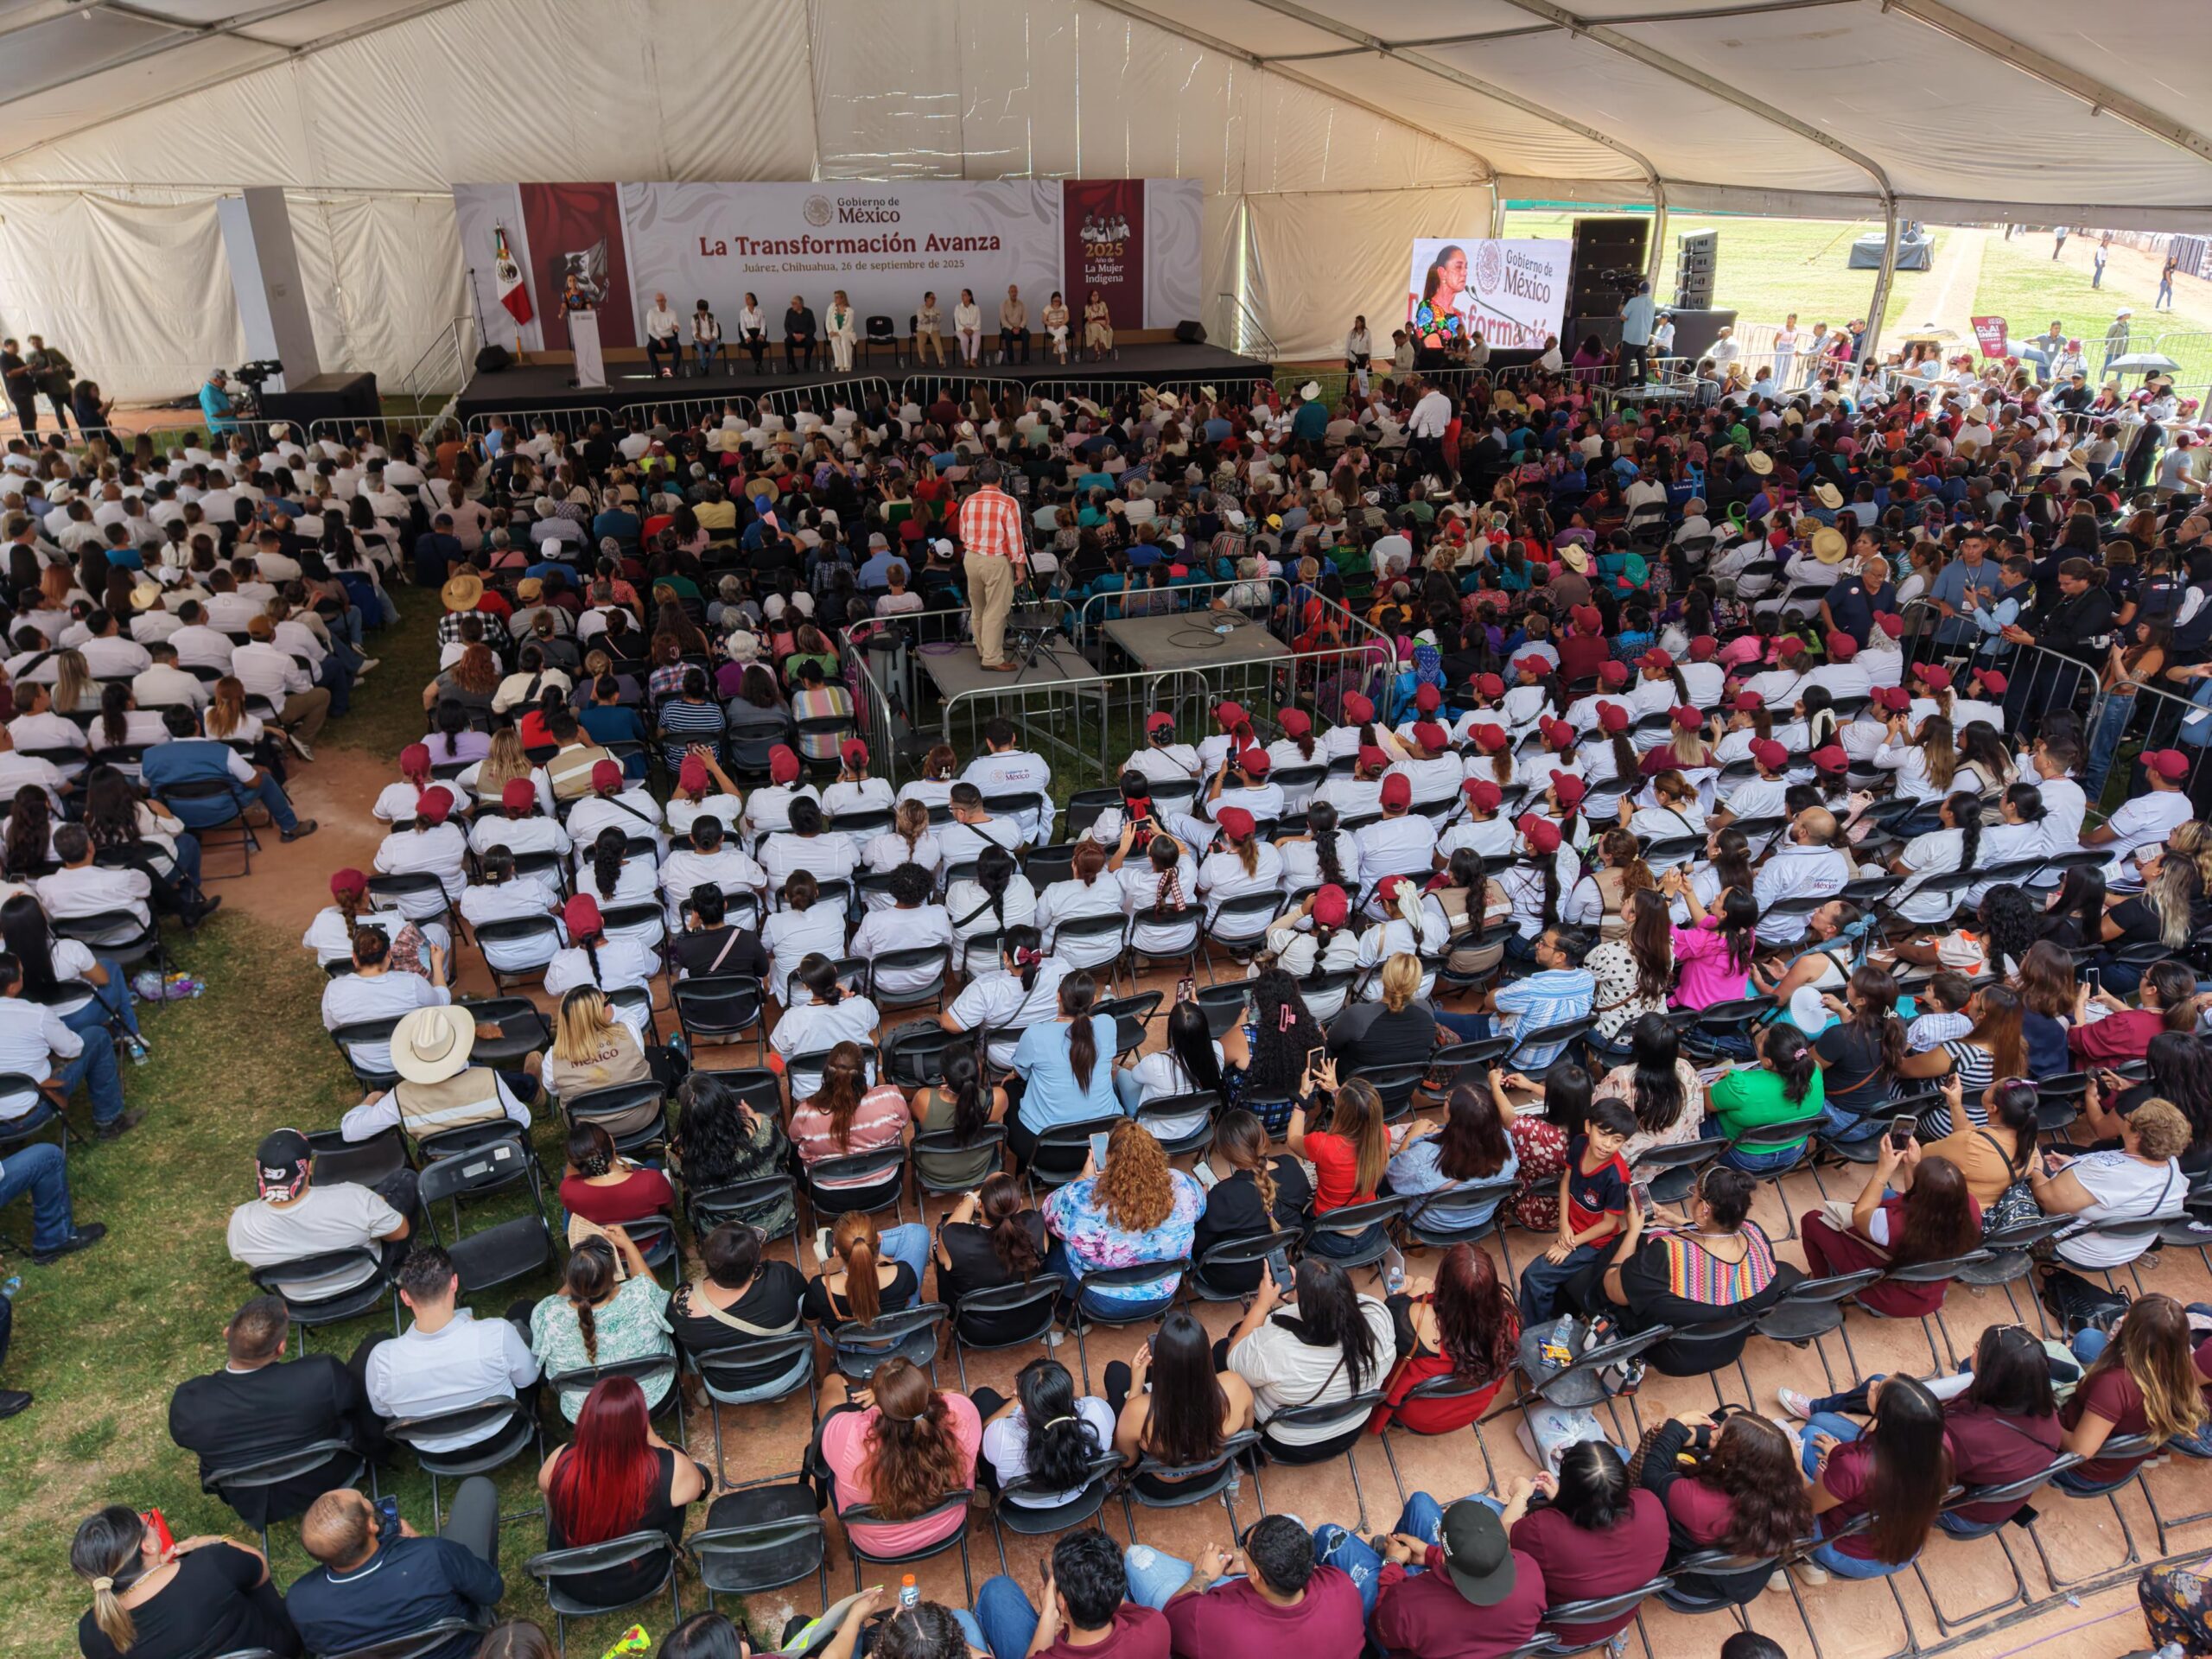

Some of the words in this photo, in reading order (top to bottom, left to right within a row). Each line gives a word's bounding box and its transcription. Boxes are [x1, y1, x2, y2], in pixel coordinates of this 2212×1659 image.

[837, 197, 886, 207] Gobierno
[887, 196, 899, 206] de
[838, 207, 900, 224] México
[699, 237, 728, 256] La
[734, 232, 917, 256] Transformación
[925, 232, 1001, 252] Avanza
[1085, 243, 1123, 257] 2025
[742, 263, 779, 273] Juárez,
[782, 262, 838, 271] Chihuahua,
[842, 262, 852, 270] 26
[855, 261, 868, 270] de
[870, 260, 925, 271] septiembre
[928, 259, 940, 268] de
[943, 259, 964, 268] 2025
[1098, 264, 1123, 274] Mujer
[1506, 249, 1542, 274] Gobierno
[1544, 262, 1553, 276] de
[1085, 274, 1123, 285] Indígena
[1503, 266, 1551, 303] México
